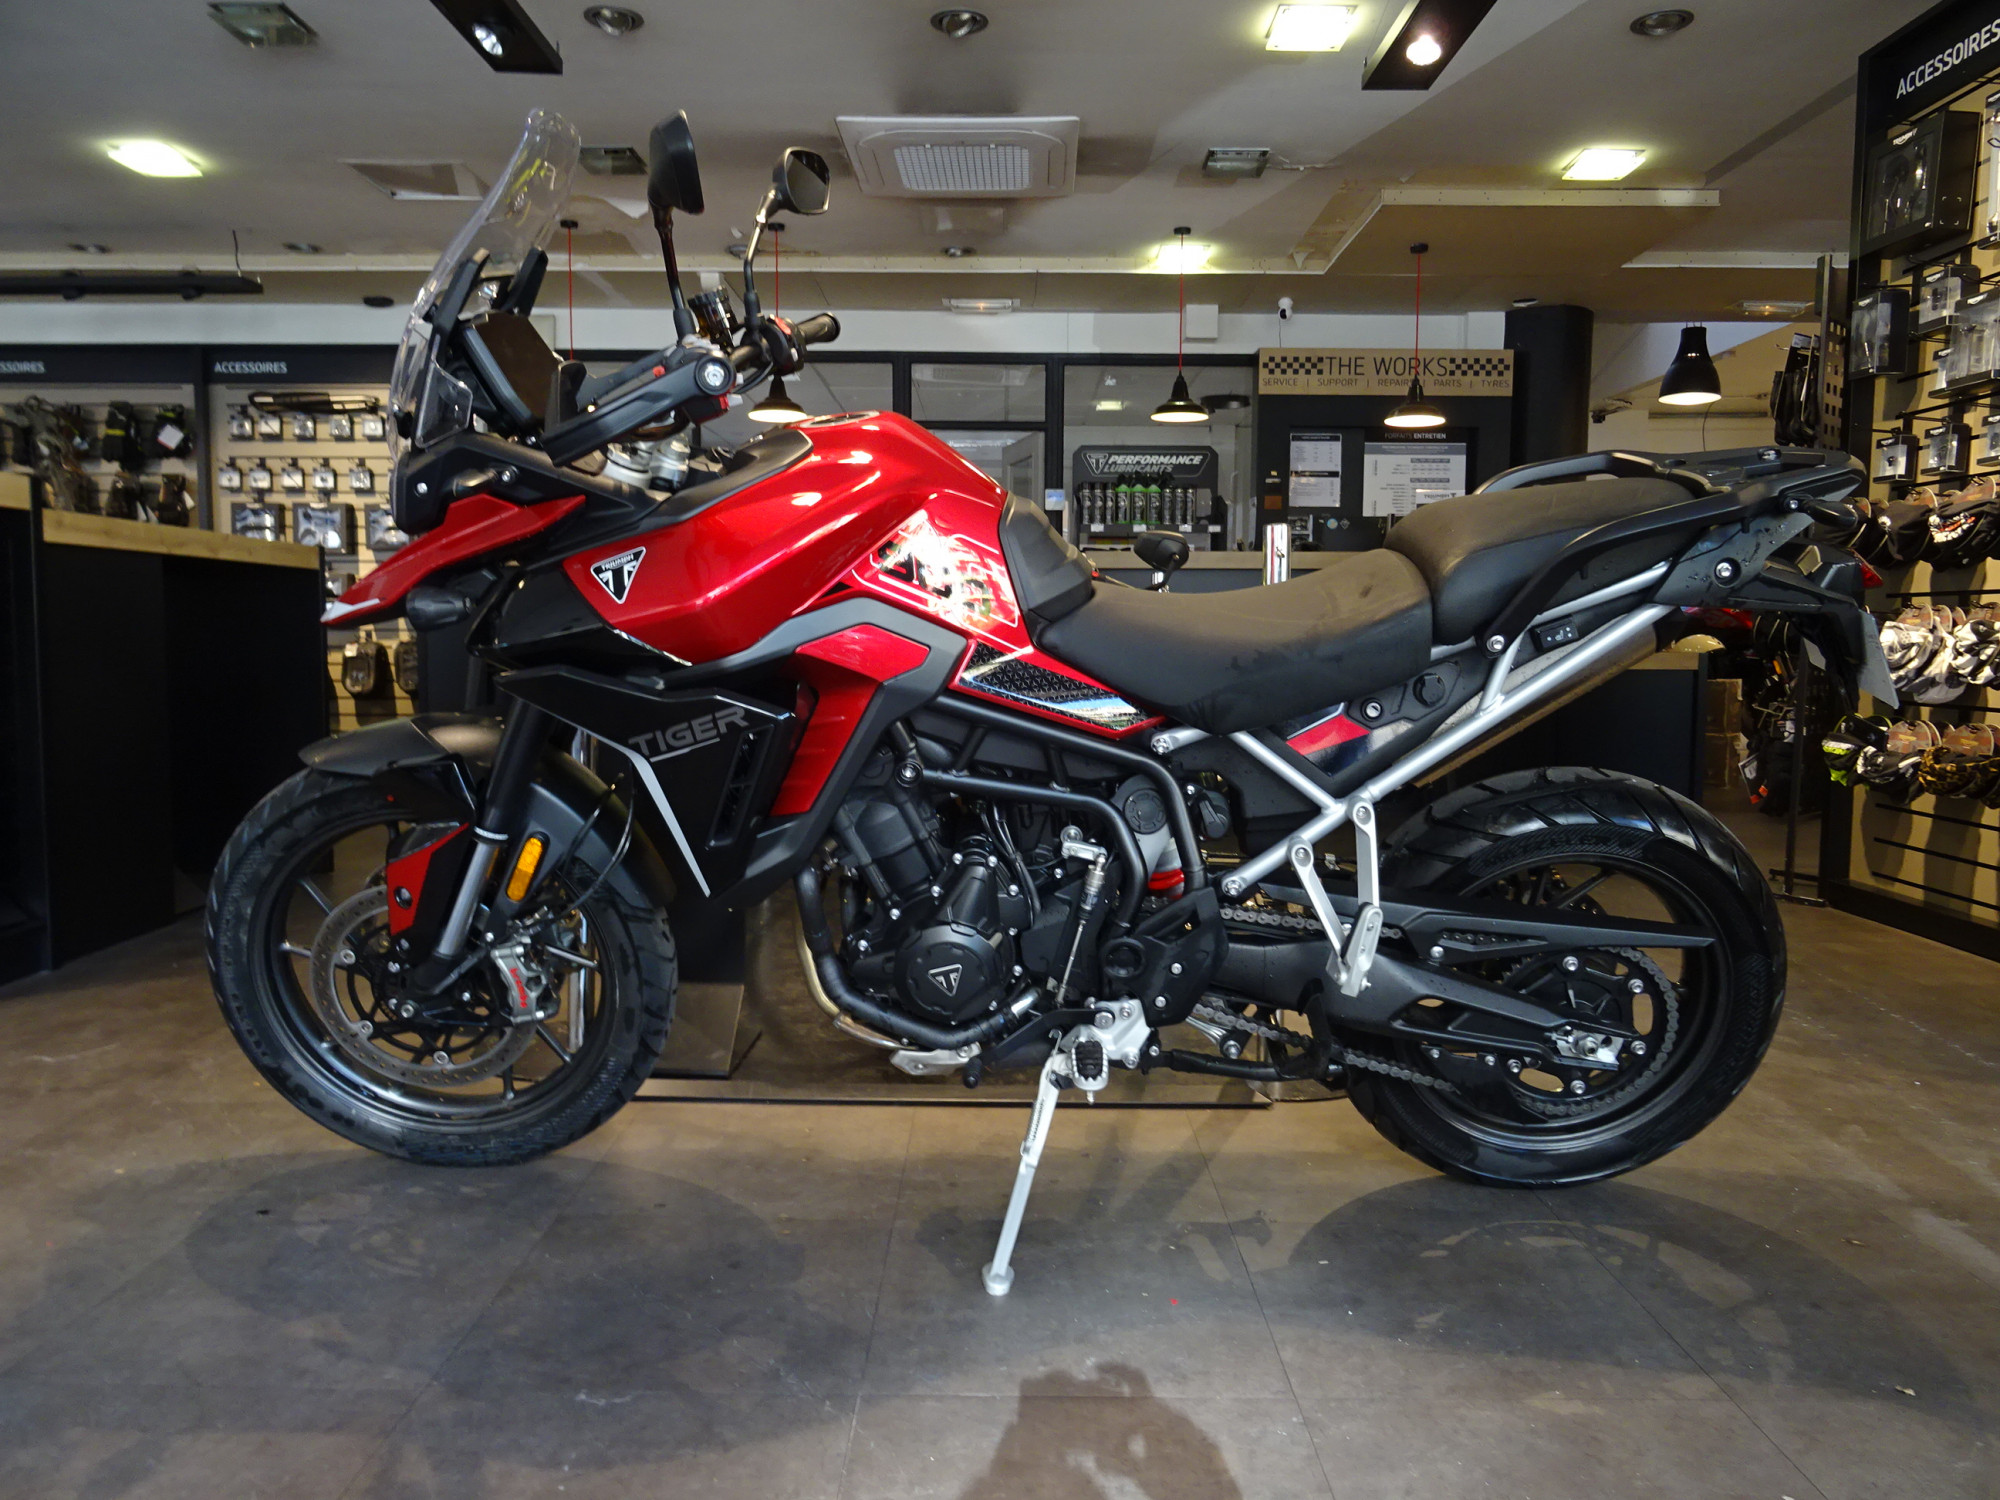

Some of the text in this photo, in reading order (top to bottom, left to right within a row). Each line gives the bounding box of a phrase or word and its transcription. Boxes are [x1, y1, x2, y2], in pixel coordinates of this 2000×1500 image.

[1896, 18, 2000, 100] ACCESSOIRES
[214, 361, 288, 374] ACCESSOIRES
[1325, 356, 1448, 376] THE WORKS
[1262, 378, 1298, 387] SERVICE
[1317, 378, 1358, 387] SUPPORT
[1434, 379, 1462, 388] PARTS
[1481, 379, 1510, 388] TYRES
[1413, 432, 1447, 440] ENTRETIEN
[1107, 454, 1203, 465] PERFORMANCE
[1103, 464, 1174, 473] LUBRICANTS
[601, 553, 635, 571] TRIUMPH
[628, 706, 750, 755] TIGER
